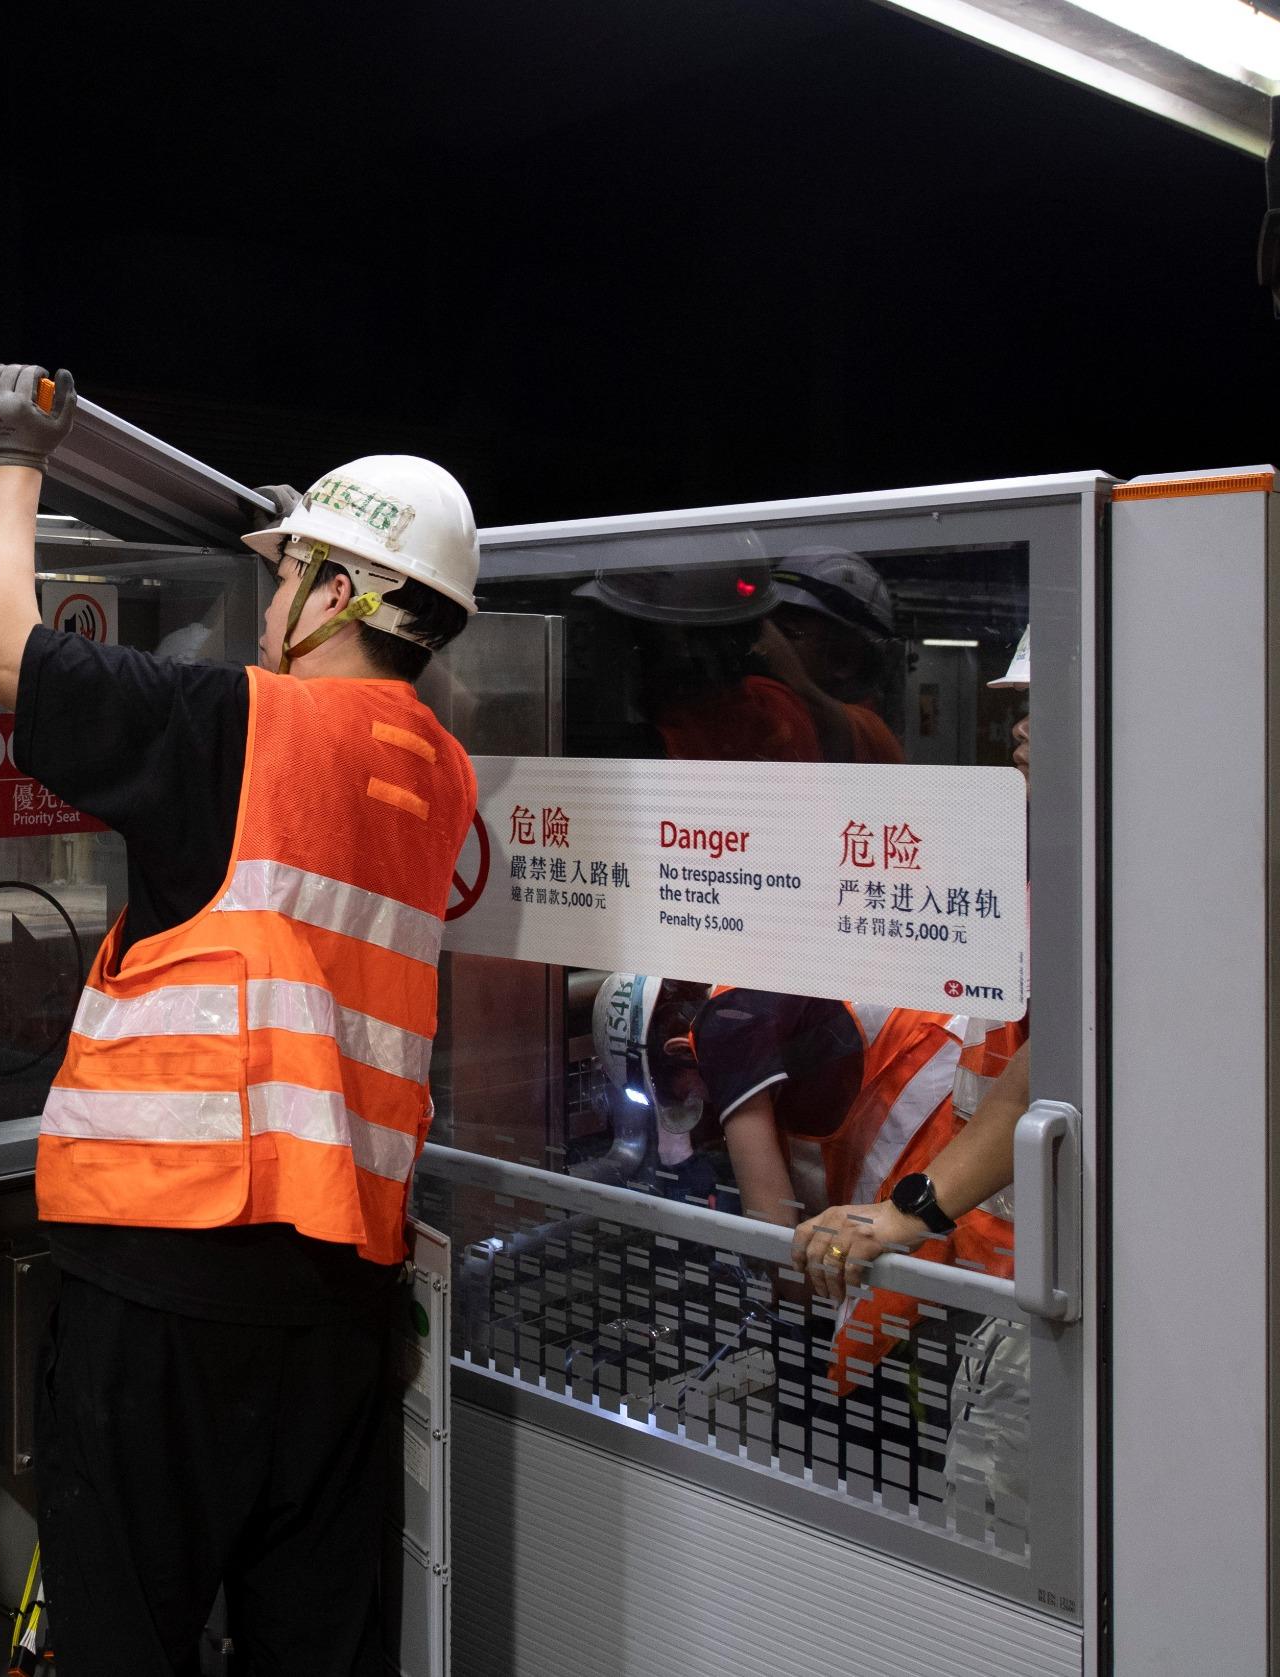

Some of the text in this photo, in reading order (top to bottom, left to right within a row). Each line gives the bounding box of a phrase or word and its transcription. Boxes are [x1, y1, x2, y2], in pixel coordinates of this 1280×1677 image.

[13, 784, 70, 811] 優先
[13, 810, 81, 826] Priority Seat
[509, 805, 570, 848] 危險
[660, 821, 750, 859] Danger
[839, 820, 922, 870] 危险
[511, 855, 631, 888] 嚴禁進入路軌
[659, 863, 801, 890] No trespassing onto
[660, 884, 720, 904] the track
[838, 879, 1001, 919] 严禁进入路轨
[660, 911, 744, 932] Penalty $5,000
[965, 984, 1004, 1001] MTR
